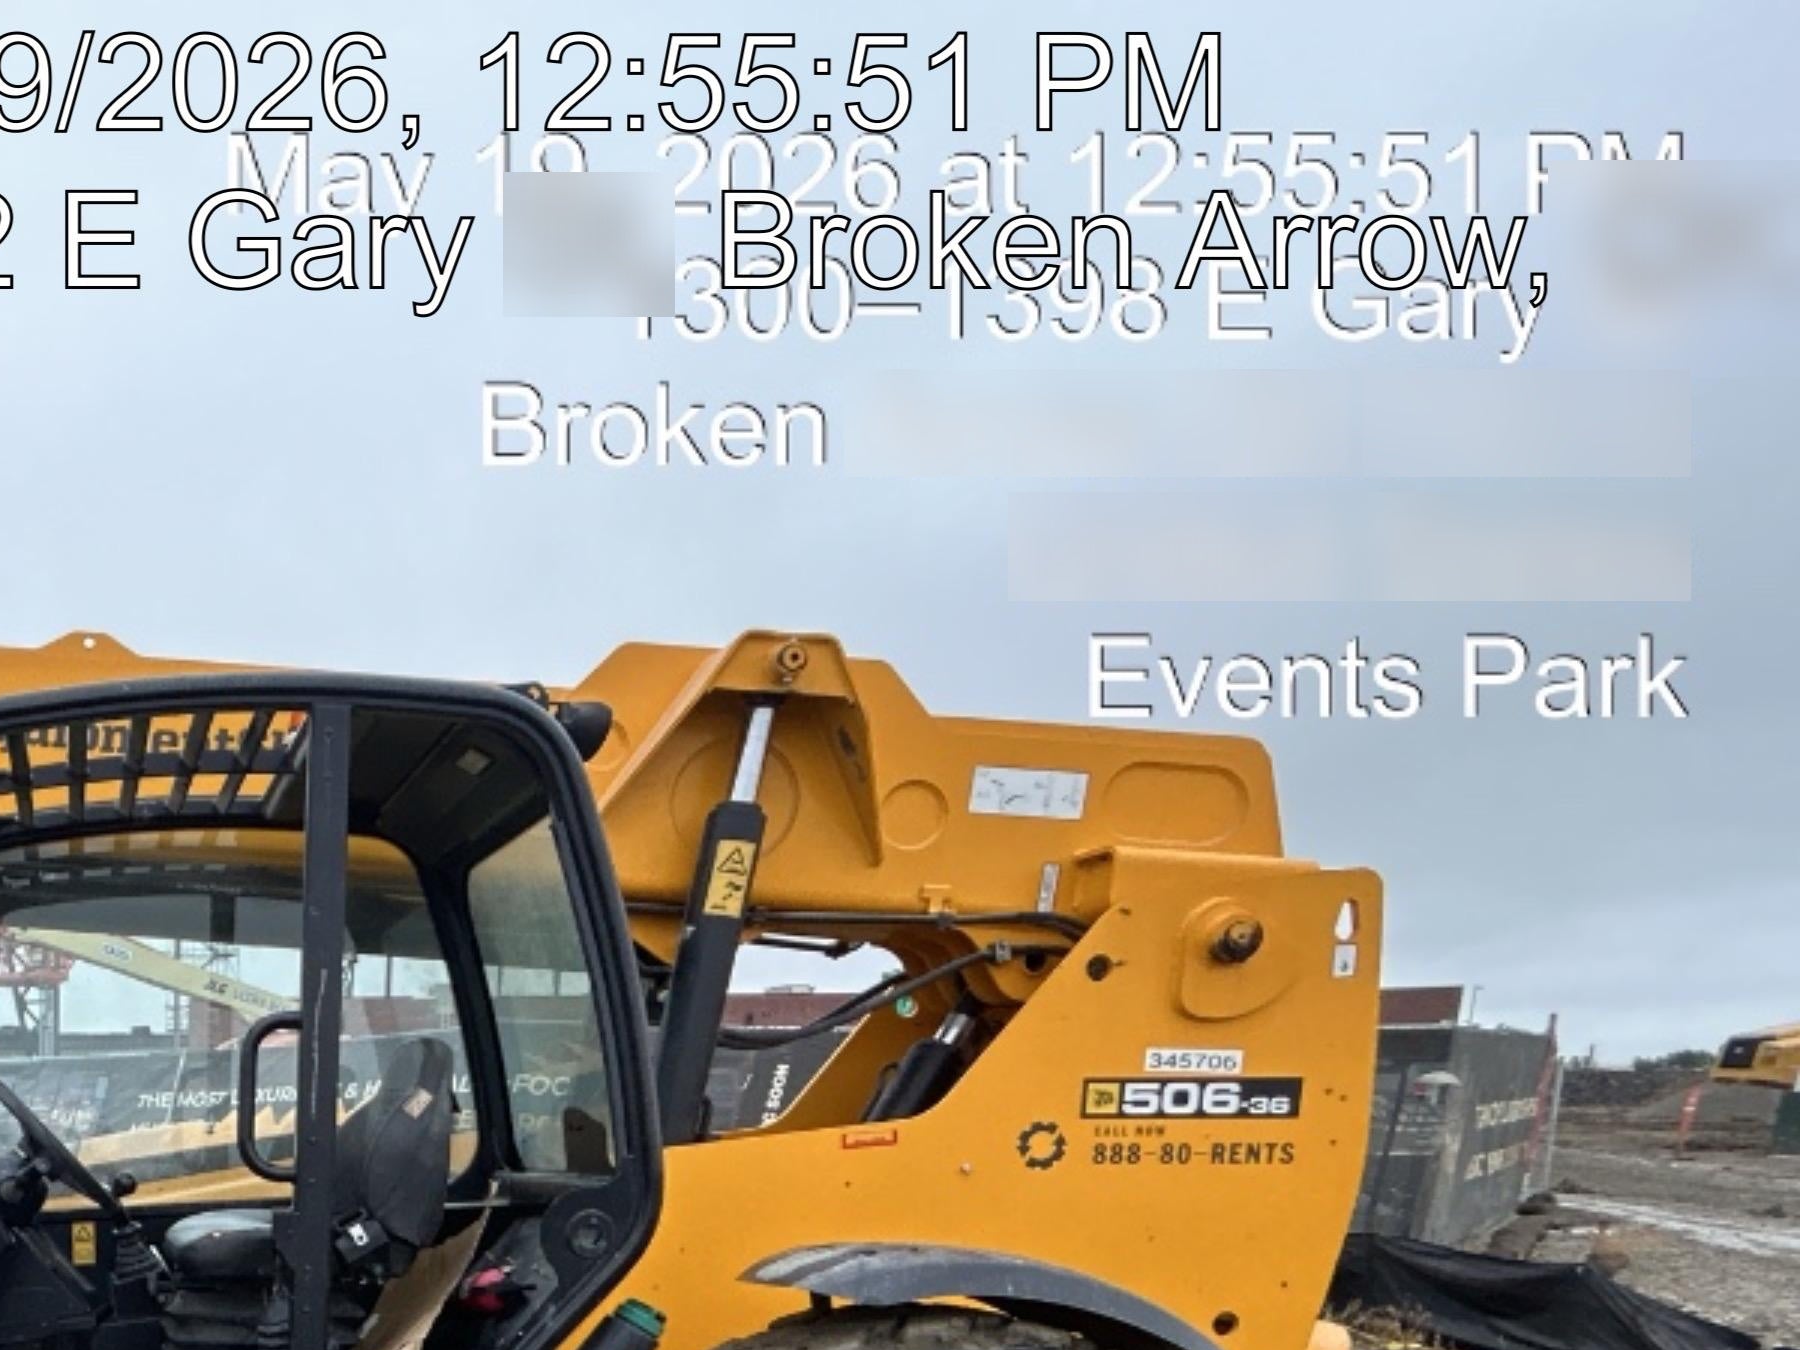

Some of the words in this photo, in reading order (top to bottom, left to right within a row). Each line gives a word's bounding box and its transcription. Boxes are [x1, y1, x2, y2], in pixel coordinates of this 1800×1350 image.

[1148, 1052, 1238, 1071] 345706
[1094, 1126, 1129, 1137] CALL
[1135, 1126, 1166, 1137] NOW
[1092, 1142, 1295, 1165] 888-80-RENTS
